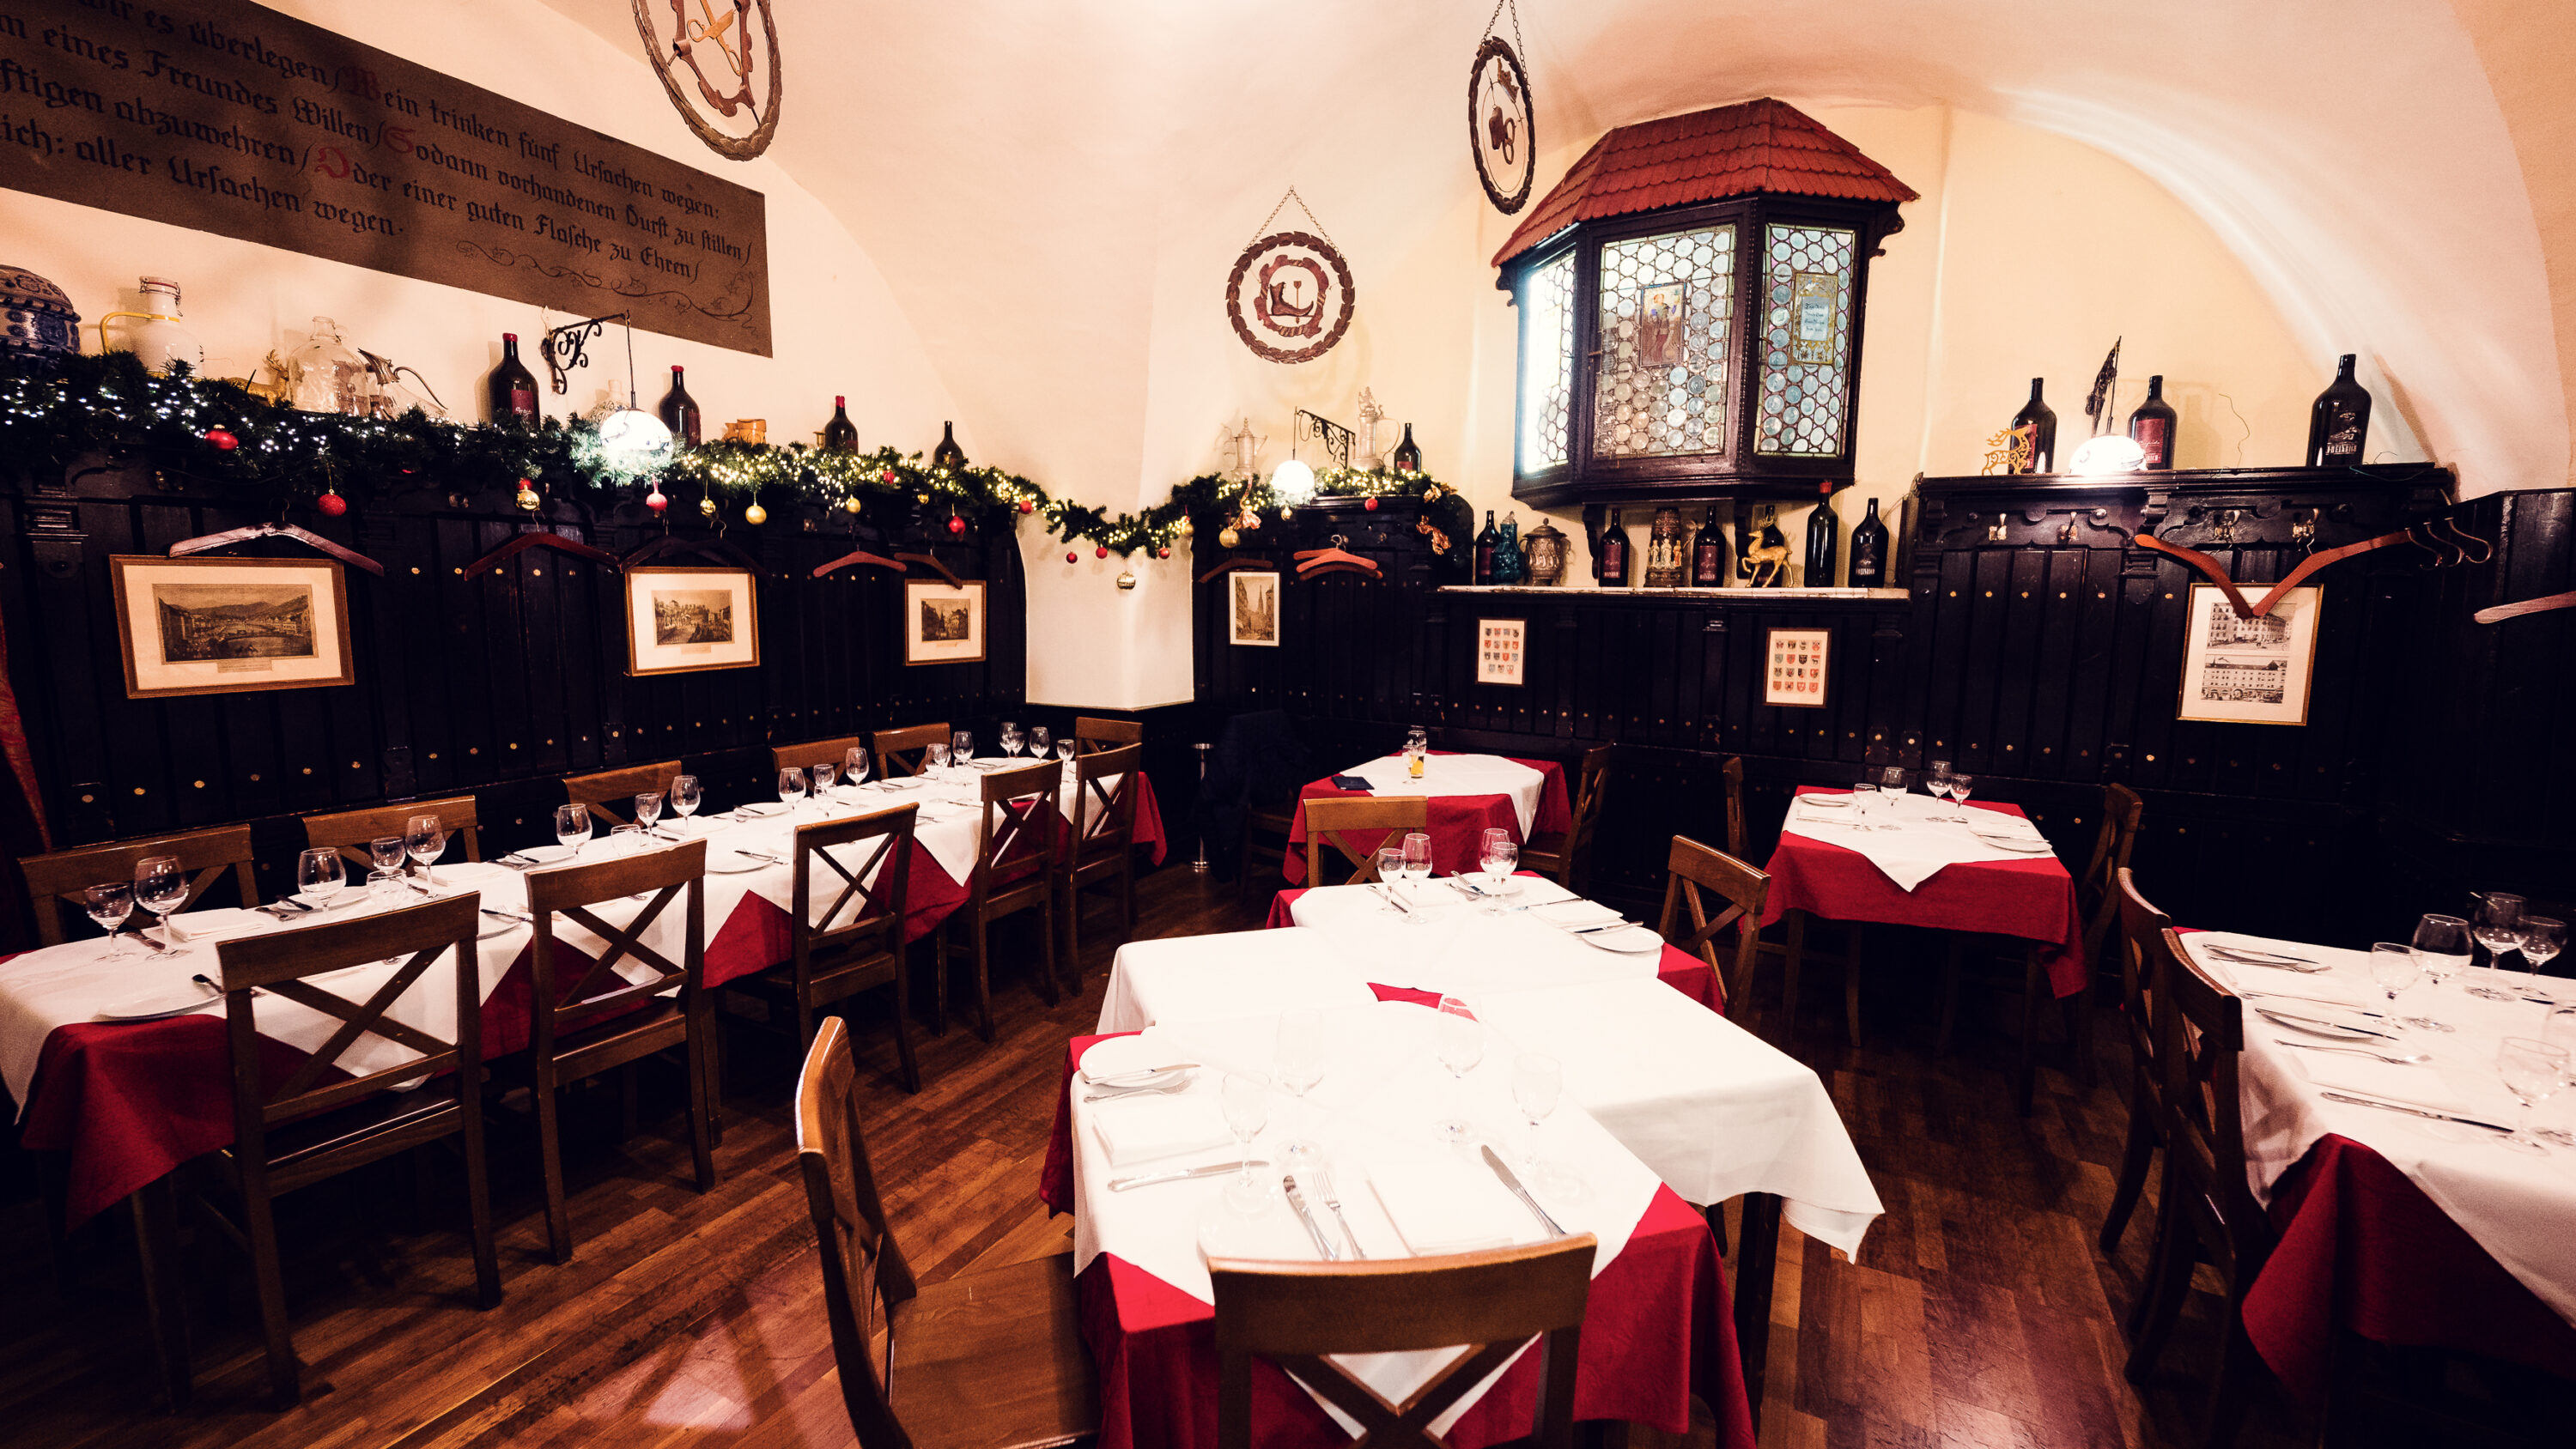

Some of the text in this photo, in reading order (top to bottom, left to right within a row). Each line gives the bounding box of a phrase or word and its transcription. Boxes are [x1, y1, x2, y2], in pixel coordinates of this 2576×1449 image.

[0, 58, 105, 113] ftigen
[315, 146, 392, 192] Oder
[403, 174, 458, 211] einer
[466, 201, 526, 230] guten
[609, 241, 630, 260] zu
[0, 114, 65, 157] ich:
[76, 136, 152, 175] aller
[313, 201, 404, 236] wegen.
[43, 24, 129, 70] eines
[138, 50, 279, 114] Freundes
[384, 126, 488, 180] Sodann
[497, 169, 617, 221] vorhandenen
[674, 227, 694, 246] zu
[144, 9, 174, 34] es
[344, 66, 419, 118] Wein
[429, 99, 511, 149] trinken
[519, 130, 561, 171] fünf
[661, 187, 720, 221] wegen:
